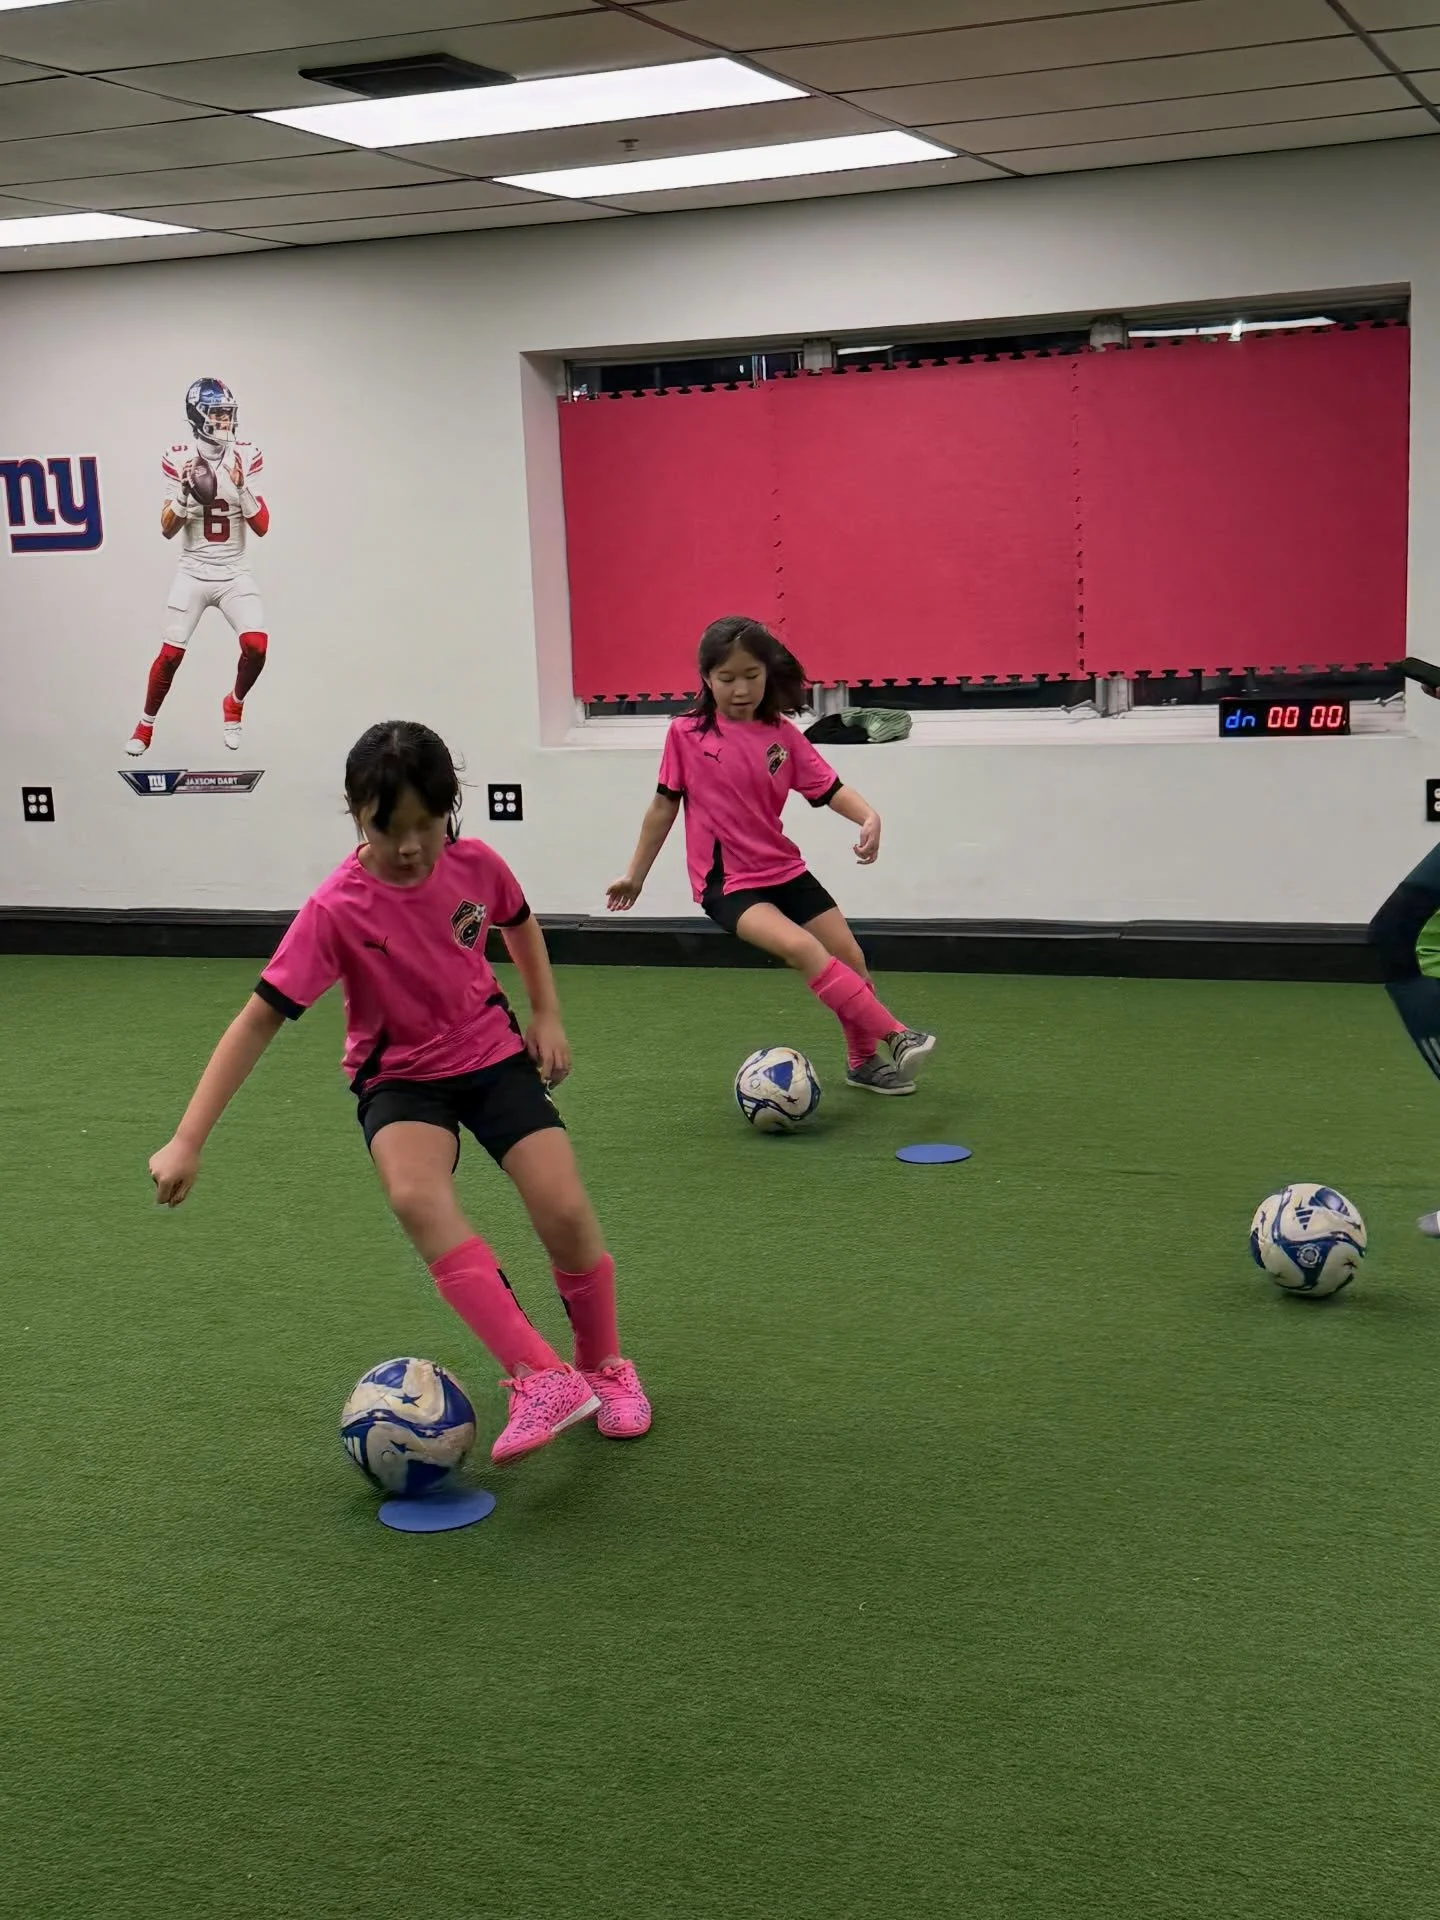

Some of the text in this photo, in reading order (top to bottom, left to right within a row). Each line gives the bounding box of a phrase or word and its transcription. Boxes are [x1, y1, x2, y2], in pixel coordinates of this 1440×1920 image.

[204, 498, 230, 542] 6
[1267, 706, 1299, 728] 00
[185, 777, 238, 785] JAXSON DART
